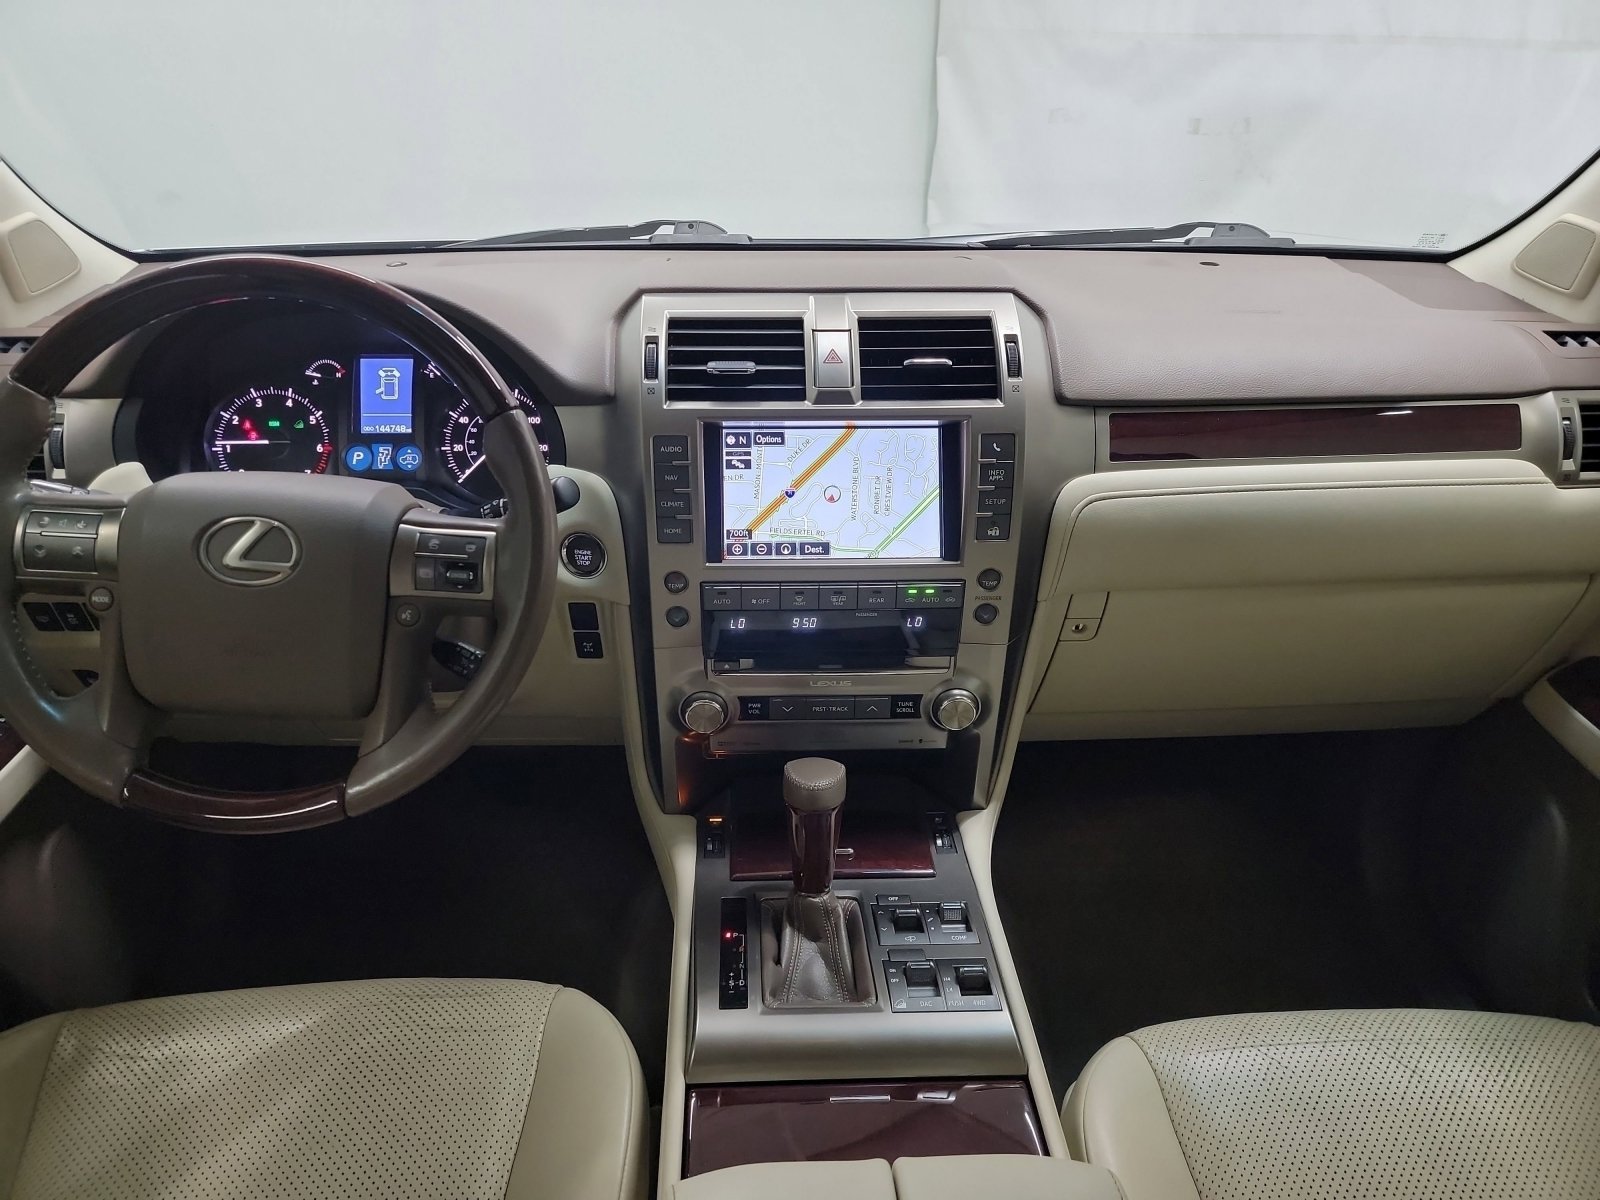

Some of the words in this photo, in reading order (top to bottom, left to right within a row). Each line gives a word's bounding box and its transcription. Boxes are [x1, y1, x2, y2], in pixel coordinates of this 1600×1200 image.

[255, 398, 262, 408] 3
[286, 398, 293, 408] 4
[232, 416, 239, 424] 2
[309, 415, 316, 424] 5
[459, 416, 469, 424] 40
[375, 424, 406, 432] 144748
[739, 436, 747, 444] N
[756, 434, 782, 444] Options
[226, 445, 231, 453] 1
[316, 444, 324, 452] 6
[453, 444, 464, 452] 20
[538, 444, 548, 452] 20
[352, 452, 364, 464] P
[787, 447, 803, 463] DUKE
[886, 467, 892, 478] DR
[874, 476, 881, 484] DR
[851, 476, 859, 522] WATERSTONE
[730, 530, 748, 538] 700ft
[804, 545, 824, 554] Dest.
